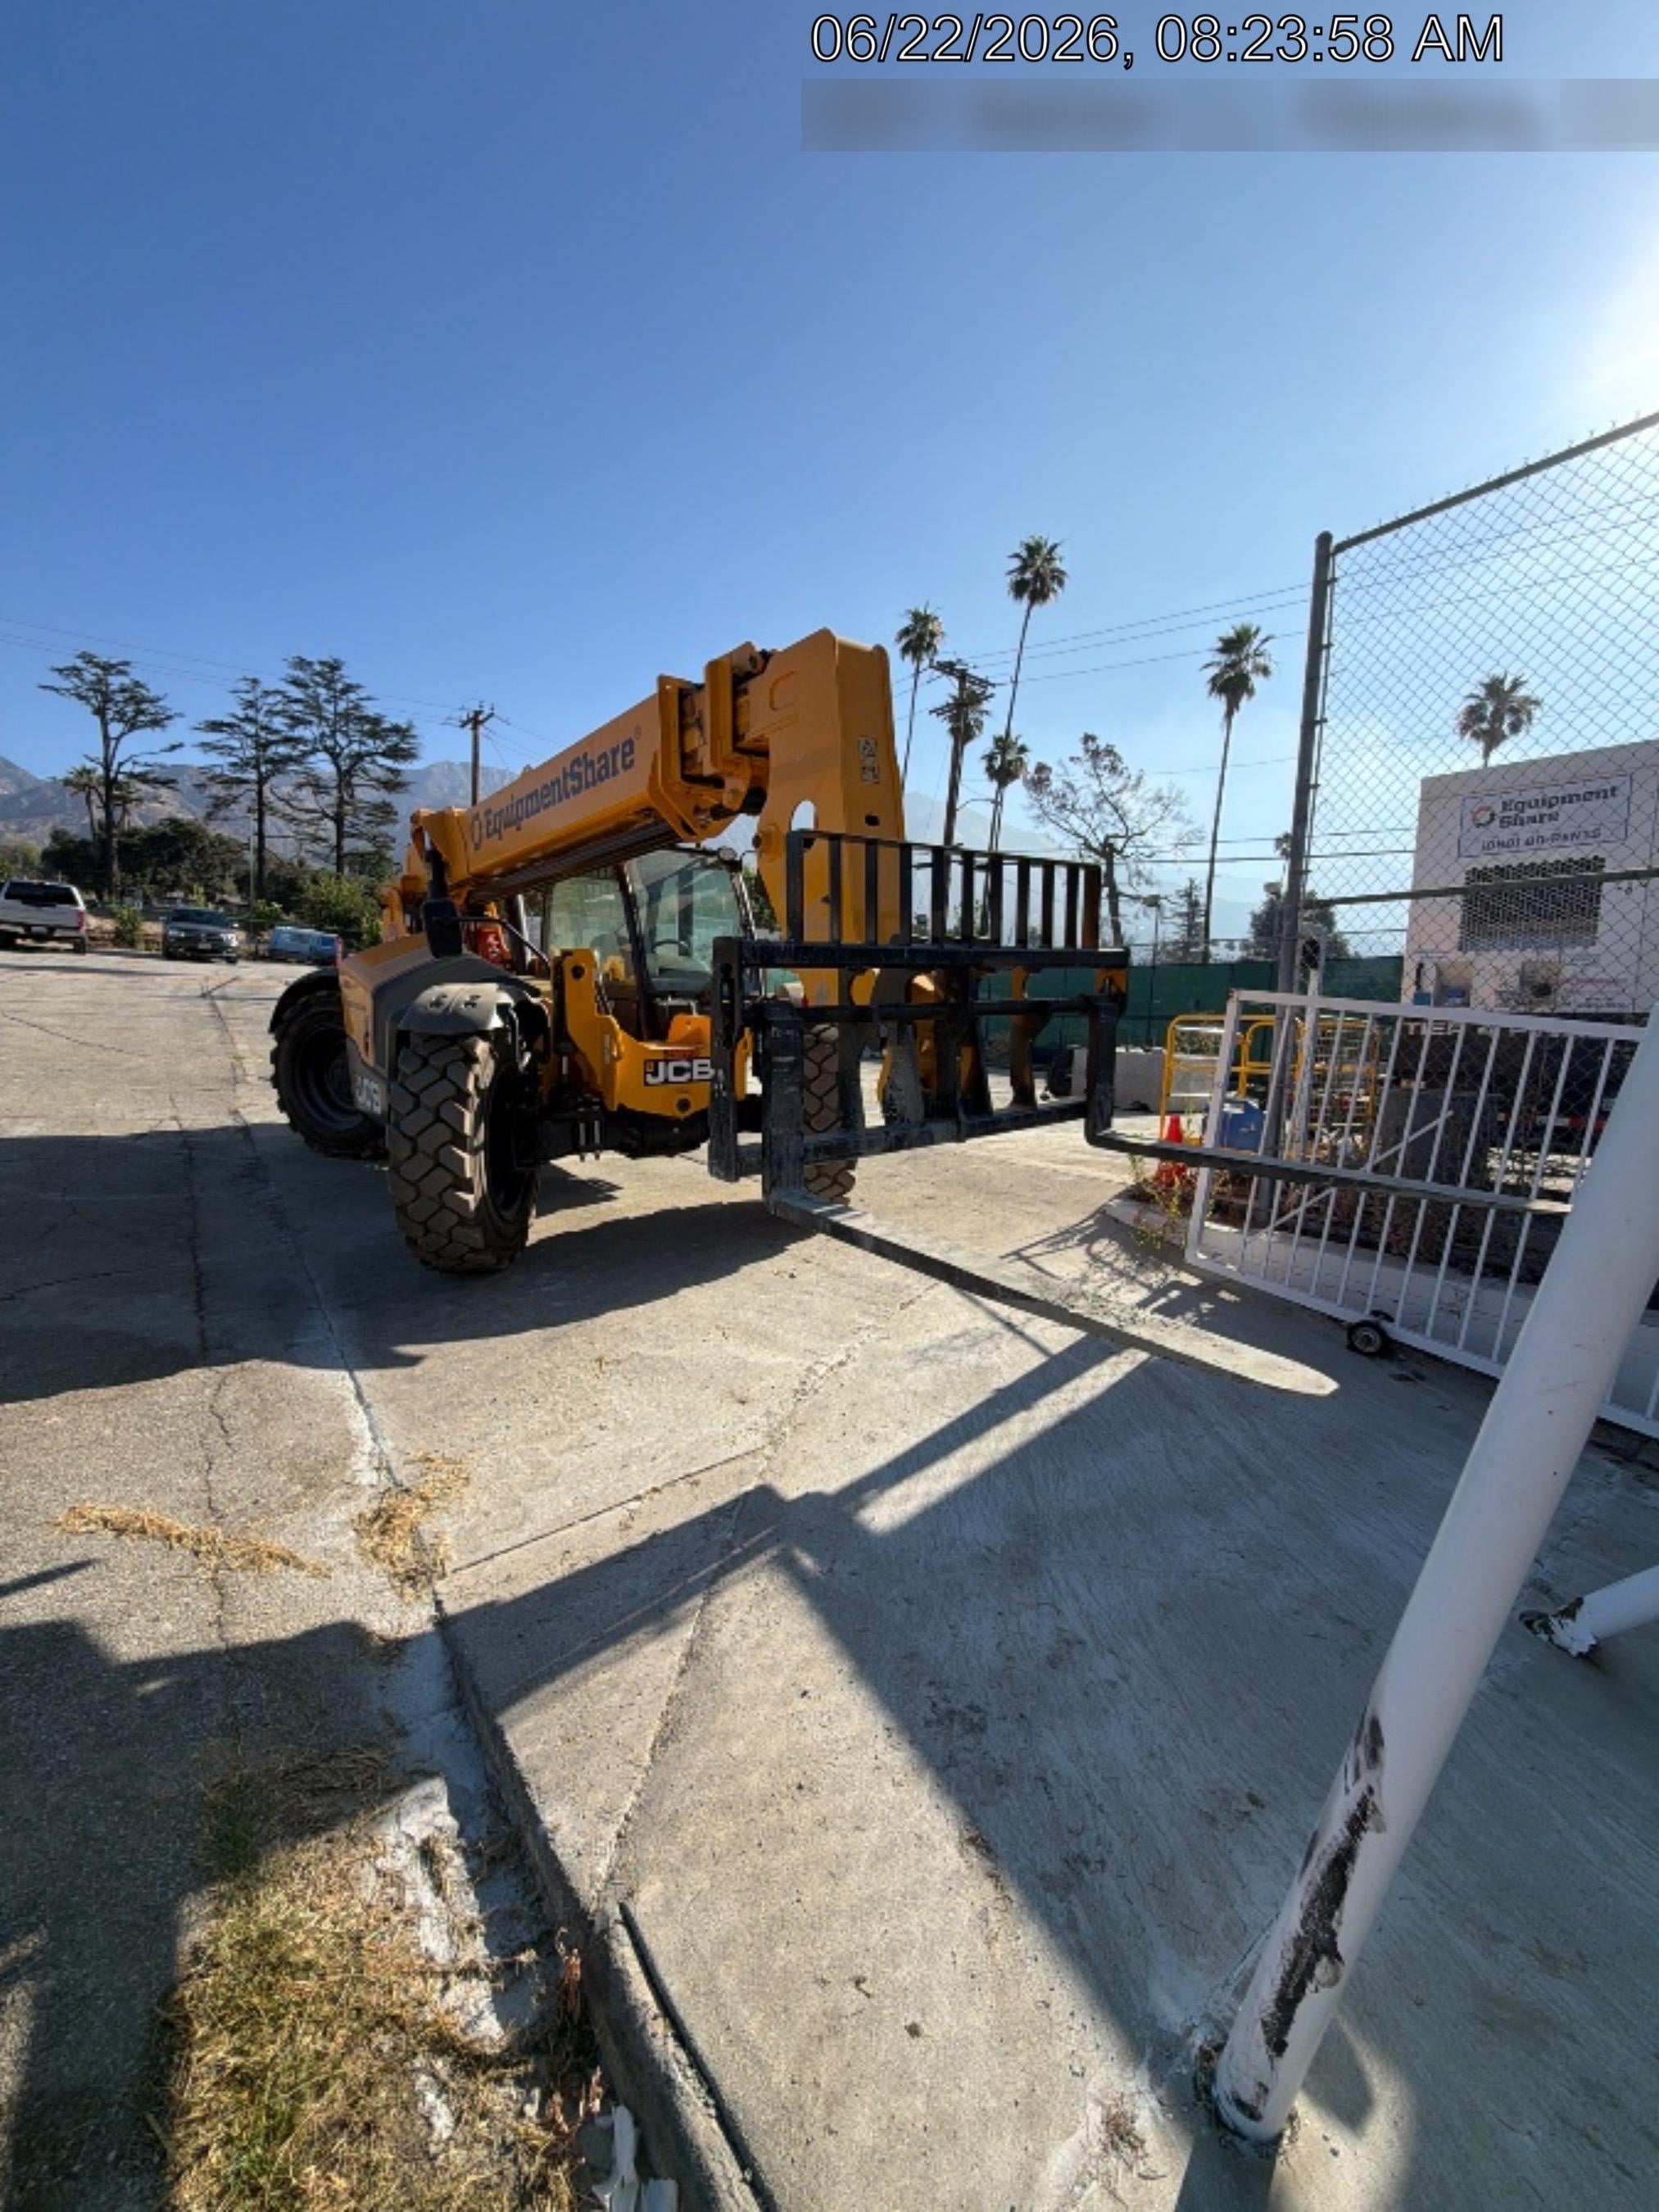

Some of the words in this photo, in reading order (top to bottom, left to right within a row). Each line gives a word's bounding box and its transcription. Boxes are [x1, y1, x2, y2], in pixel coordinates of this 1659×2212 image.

[1500, 786, 1619, 814] Equipment
[1499, 811, 1560, 829] Share
[646, 1058, 715, 1086] JCB
